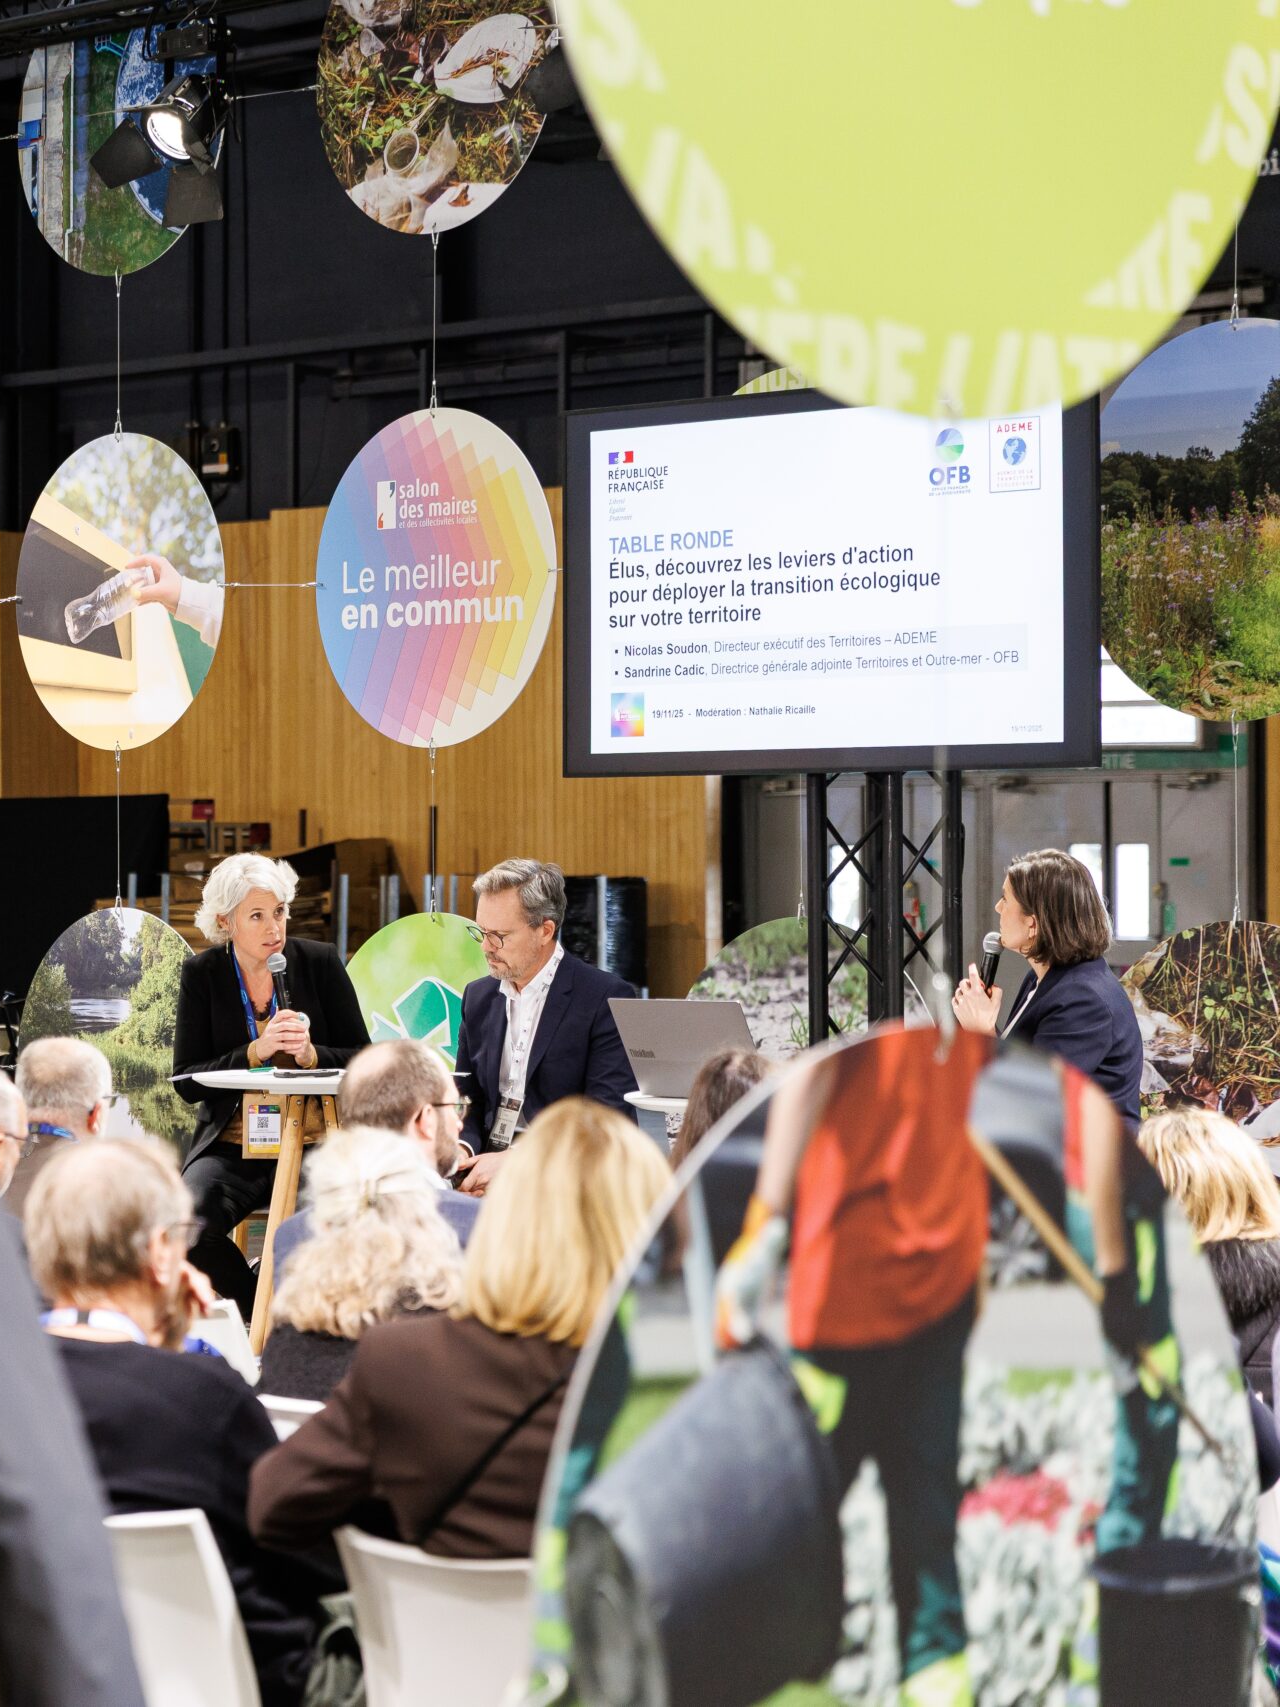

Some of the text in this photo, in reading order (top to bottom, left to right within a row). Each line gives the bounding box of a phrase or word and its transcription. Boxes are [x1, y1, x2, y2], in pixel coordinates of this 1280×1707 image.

[997, 422, 1033, 433] ADEME
[608, 466, 669, 480] RÉPUBLIQUE
[929, 465, 971, 486] OFB
[399, 478, 439, 499] salon
[608, 479, 665, 493] FRANÇAISE
[399, 496, 478, 519] des maires
[609, 529, 734, 554] TABLE RONDE
[342, 554, 502, 594] Le meilleur
[609, 544, 913, 580] Élus, découvrez les leviers d'action
[609, 569, 941, 608] pour déployer la transition écologique
[342, 594, 524, 630] en commun
[609, 604, 761, 628] sur votre territoire
[624, 644, 663, 657] Nicolas
[666, 642, 711, 655] Soudon,
[714, 640, 760, 653] Directeur
[763, 637, 804, 651] exécutif
[807, 636, 826, 649] des
[829, 634, 882, 648] Territoires
[894, 631, 938, 645] ADEME
[624, 665, 671, 679] Sandrine
[674, 663, 708, 677] Cadic,
[711, 661, 759, 675] Directrice
[762, 659, 808, 675] générale
[810, 658, 853, 674] adjointe
[856, 656, 909, 669] Territoires
[912, 656, 923, 667] et
[925, 653, 982, 666] Outre-mer
[993, 650, 1020, 664] OFB
[652, 709, 684, 719] 19/11/25
[695, 707, 742, 717] Modération
[749, 706, 783, 716] Nathalie
[785, 705, 816, 715] Ricaille
